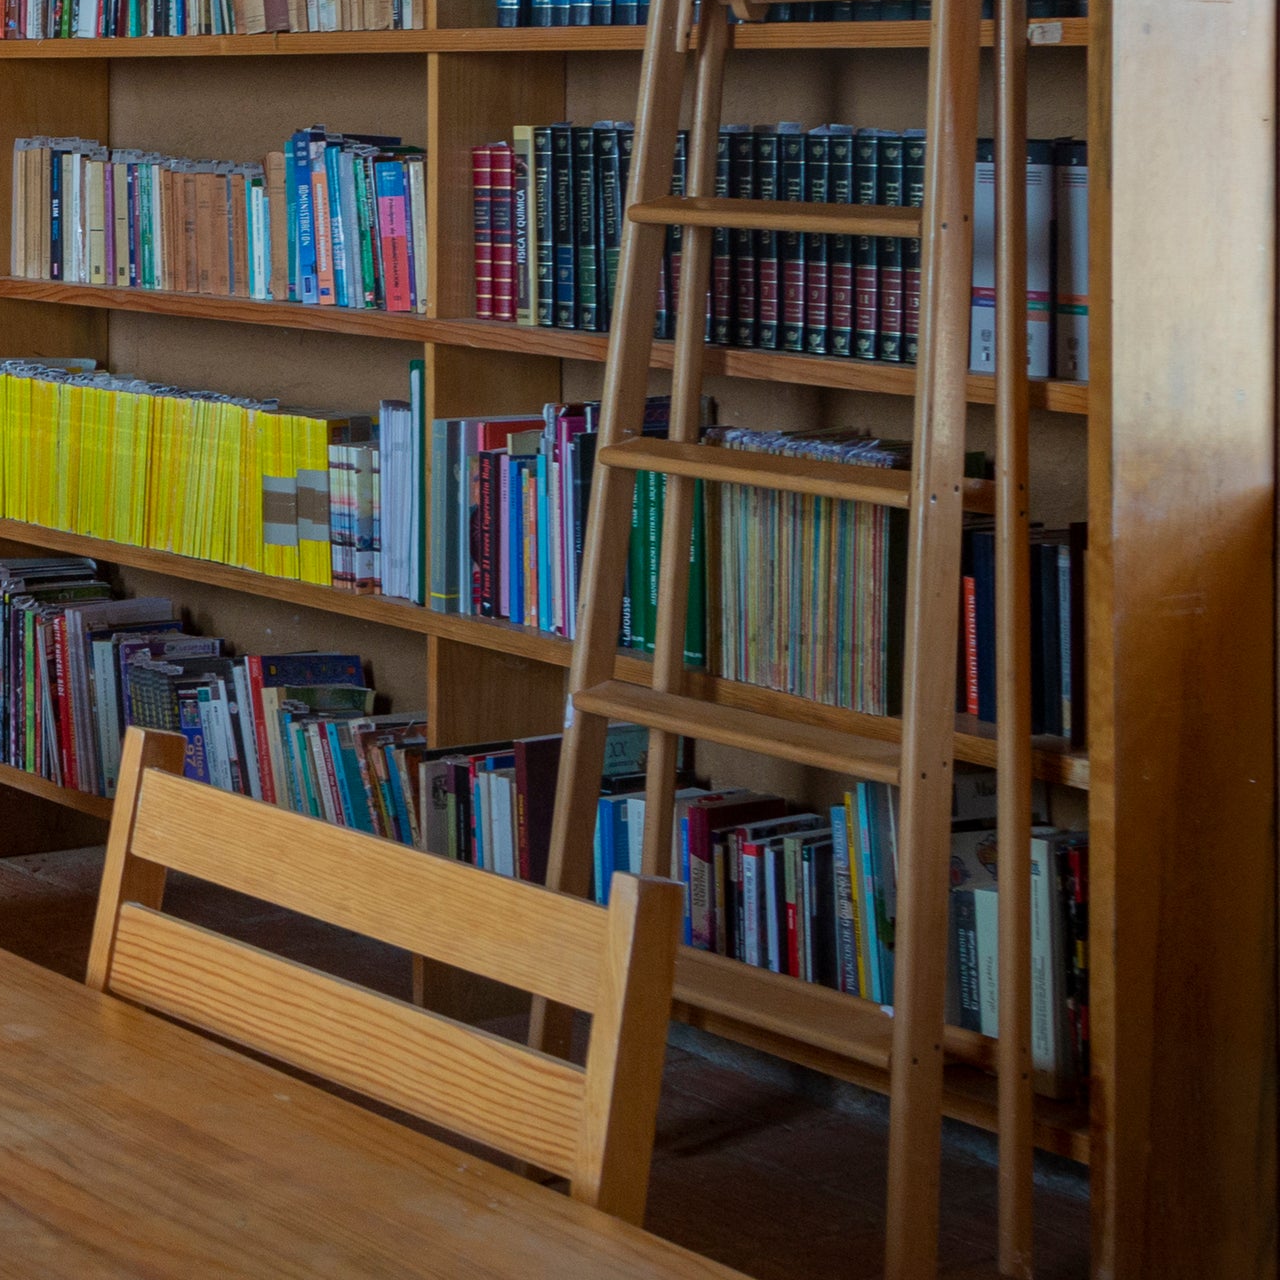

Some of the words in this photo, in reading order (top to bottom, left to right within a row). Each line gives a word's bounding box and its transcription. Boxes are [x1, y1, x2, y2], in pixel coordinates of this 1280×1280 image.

[51, 198, 59, 218] SLIM
[515, 189, 526, 228] QUÍMICA
[516, 237, 526, 263] FÍSICA
[620, 596, 631, 641] Larousse
